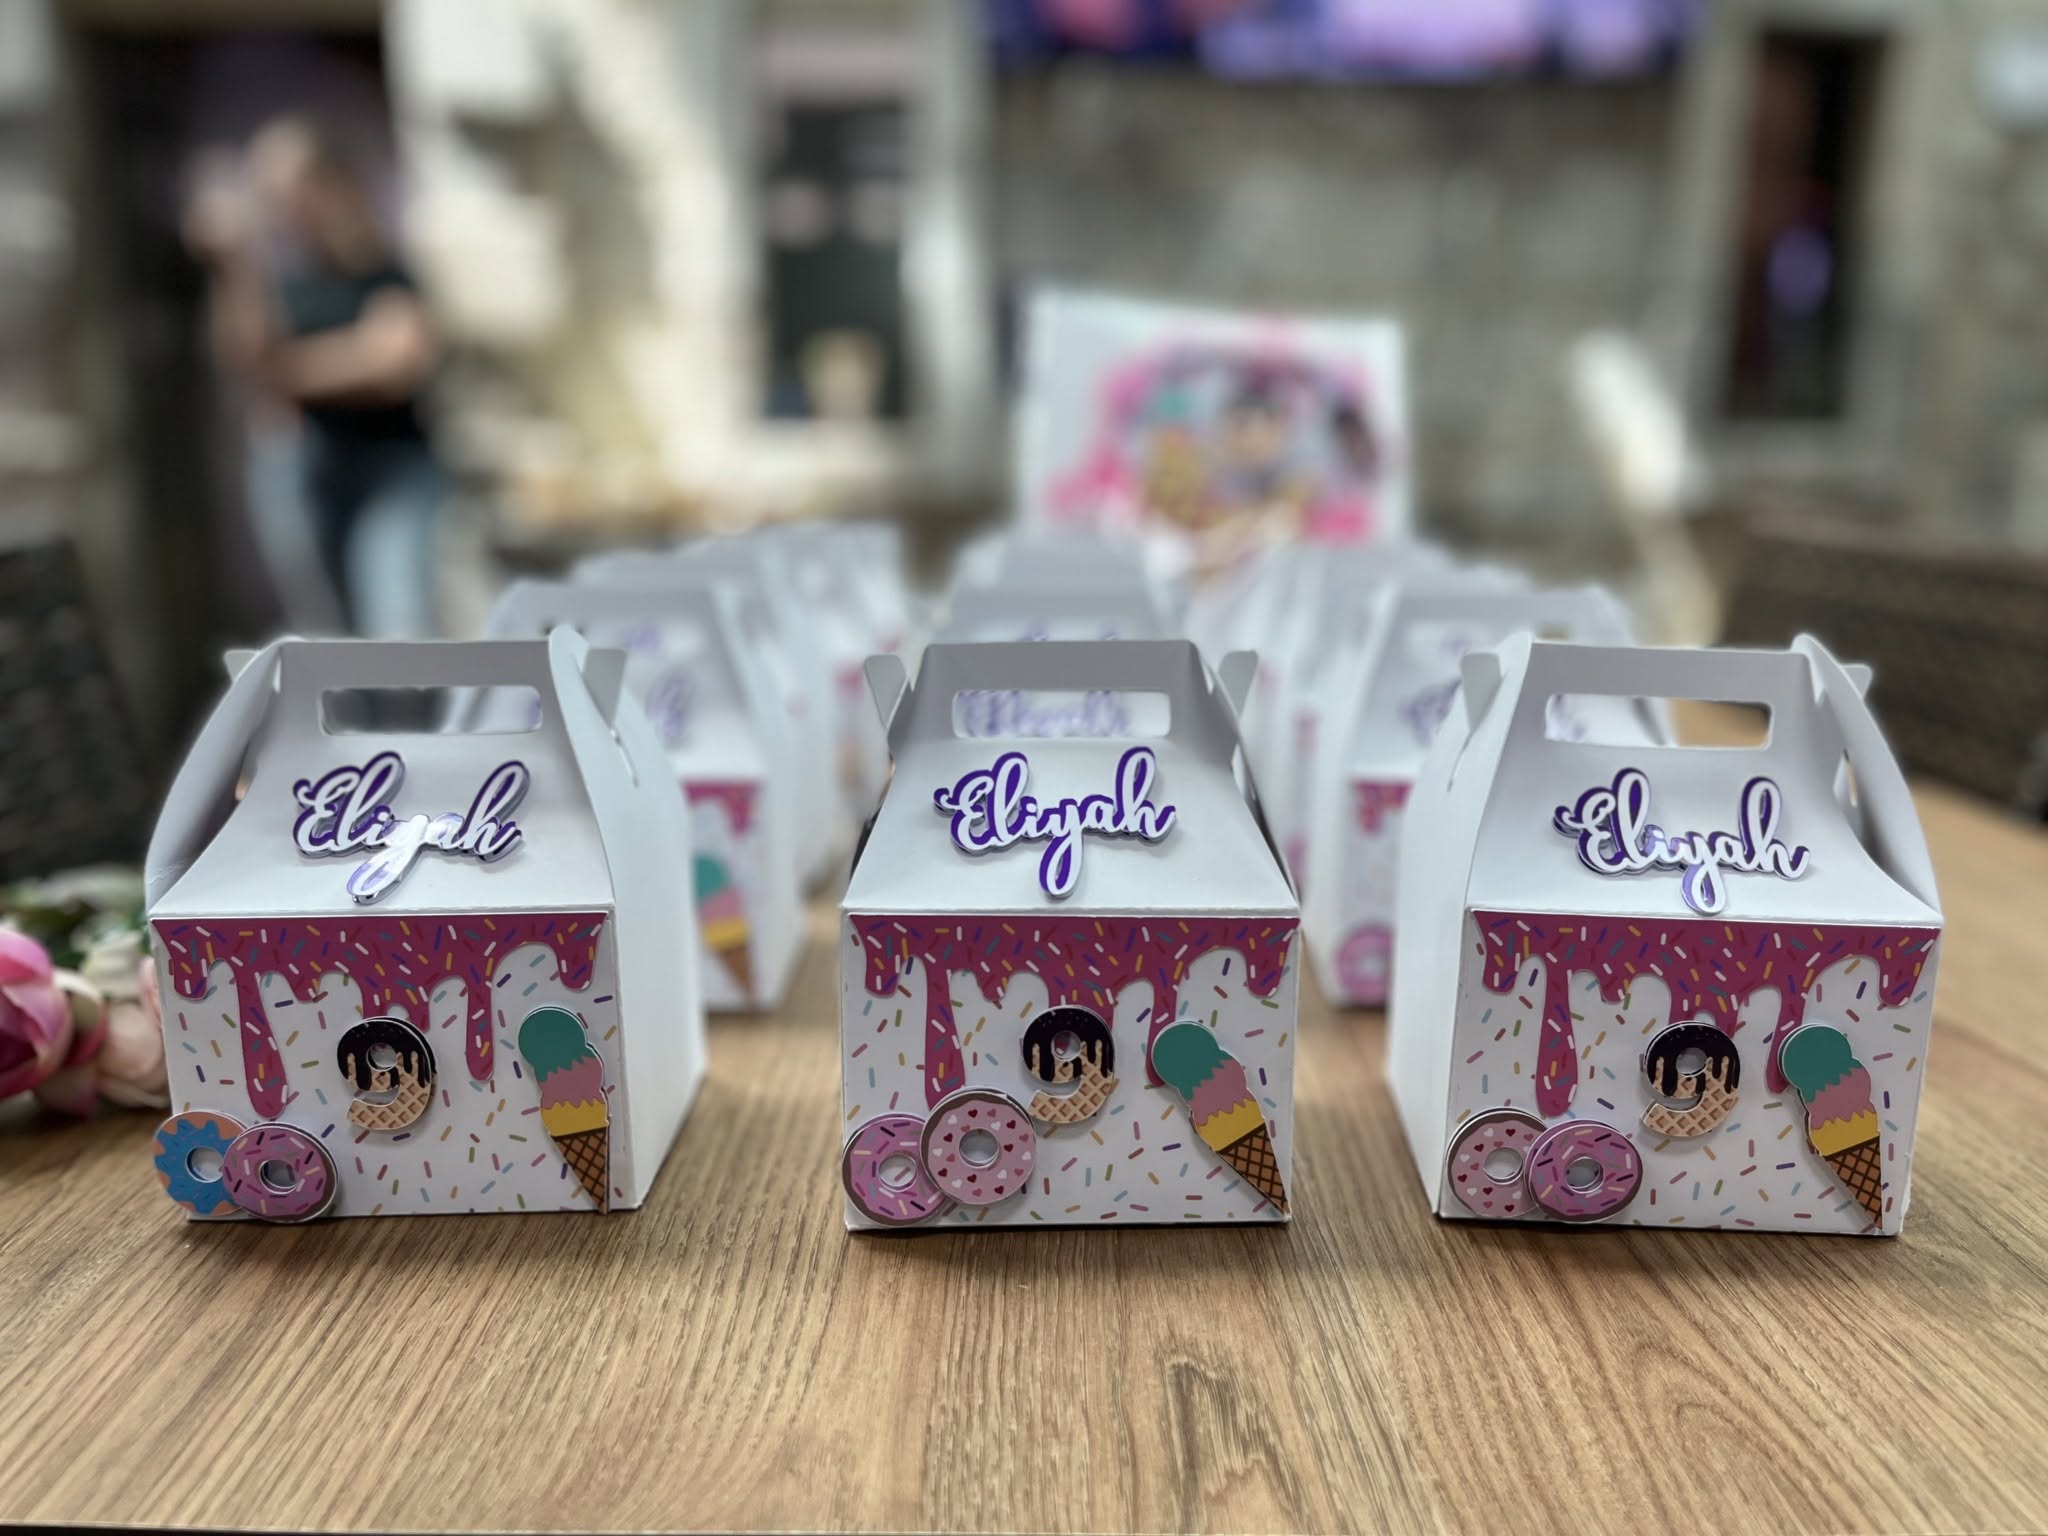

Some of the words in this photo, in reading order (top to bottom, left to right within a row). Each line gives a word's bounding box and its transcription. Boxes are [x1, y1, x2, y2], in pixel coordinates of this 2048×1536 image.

[293, 751, 529, 903] Eliyah
[934, 747, 1176, 897] Eliyah
[1553, 768, 1810, 915] Eliyah
[337, 1016, 437, 1130] 9
[1023, 1005, 1114, 1124] 9
[1641, 1021, 1740, 1136] 9
